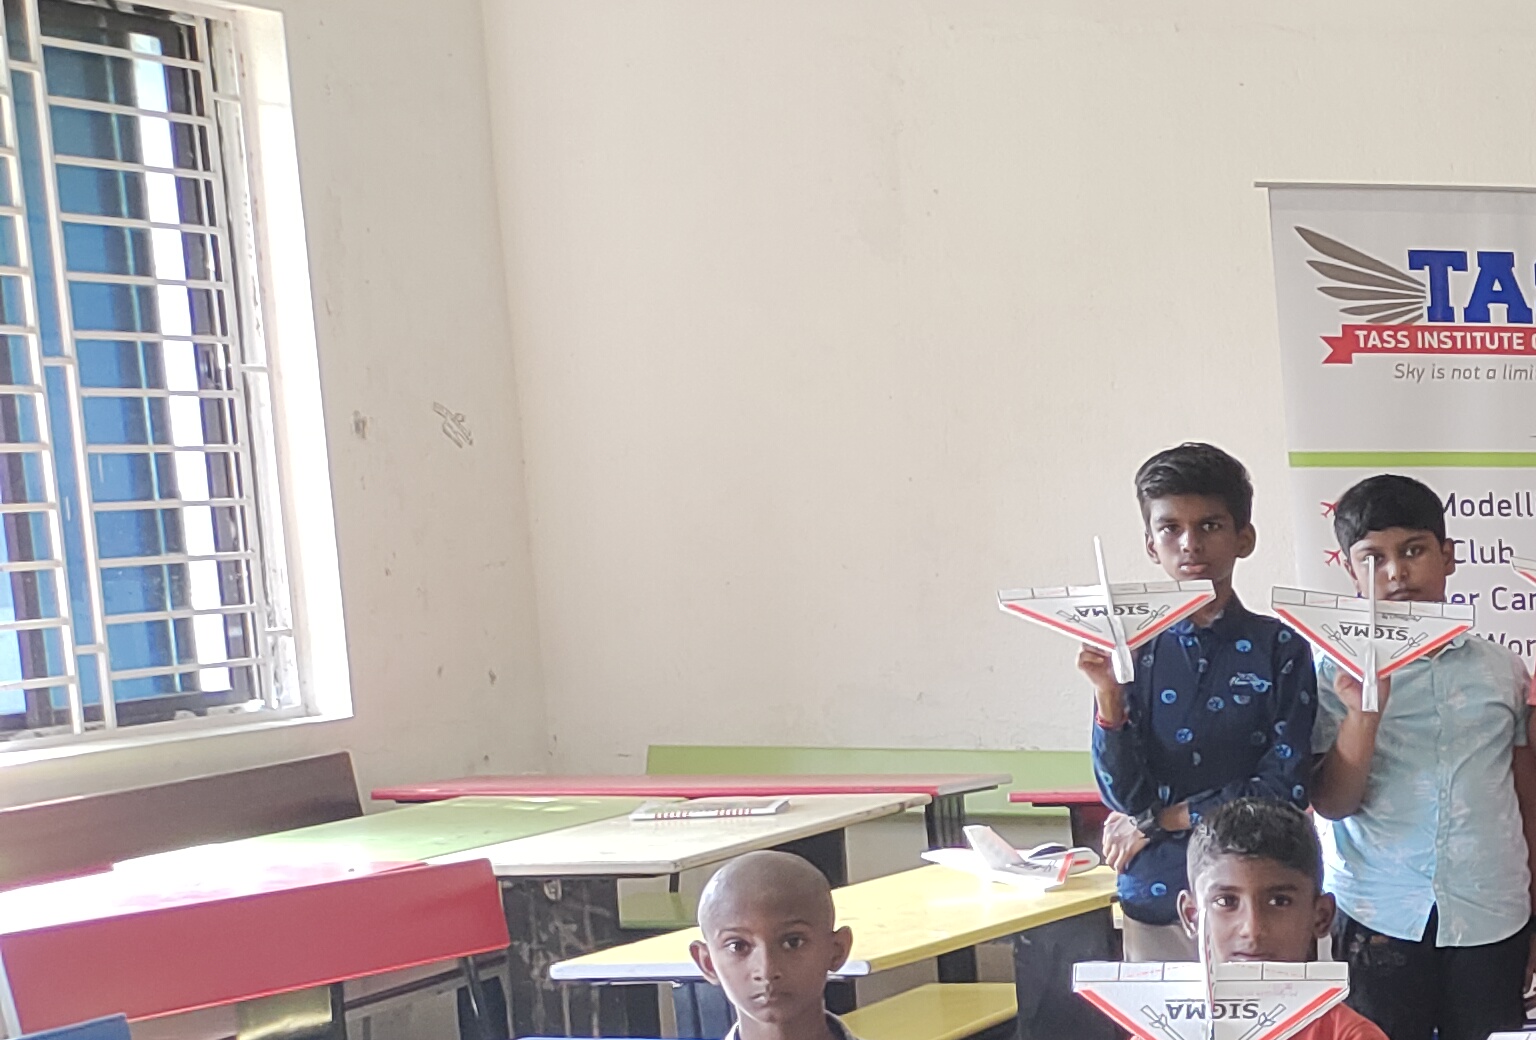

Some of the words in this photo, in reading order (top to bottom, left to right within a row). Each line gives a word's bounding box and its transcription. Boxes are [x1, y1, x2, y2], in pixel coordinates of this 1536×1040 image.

[1354, 330, 1410, 349] TASS
[1416, 331, 1524, 351] INSTITUTE
[1394, 363, 1425, 384] Sky
[1431, 364, 1445, 381] is
[1451, 364, 1481, 381] not
[1486, 368, 1498, 381] a
[1453, 539, 1515, 565] Club
[1076, 604, 1150, 618] SIGMA
[1166, 1003, 1259, 1020] SIGMA
